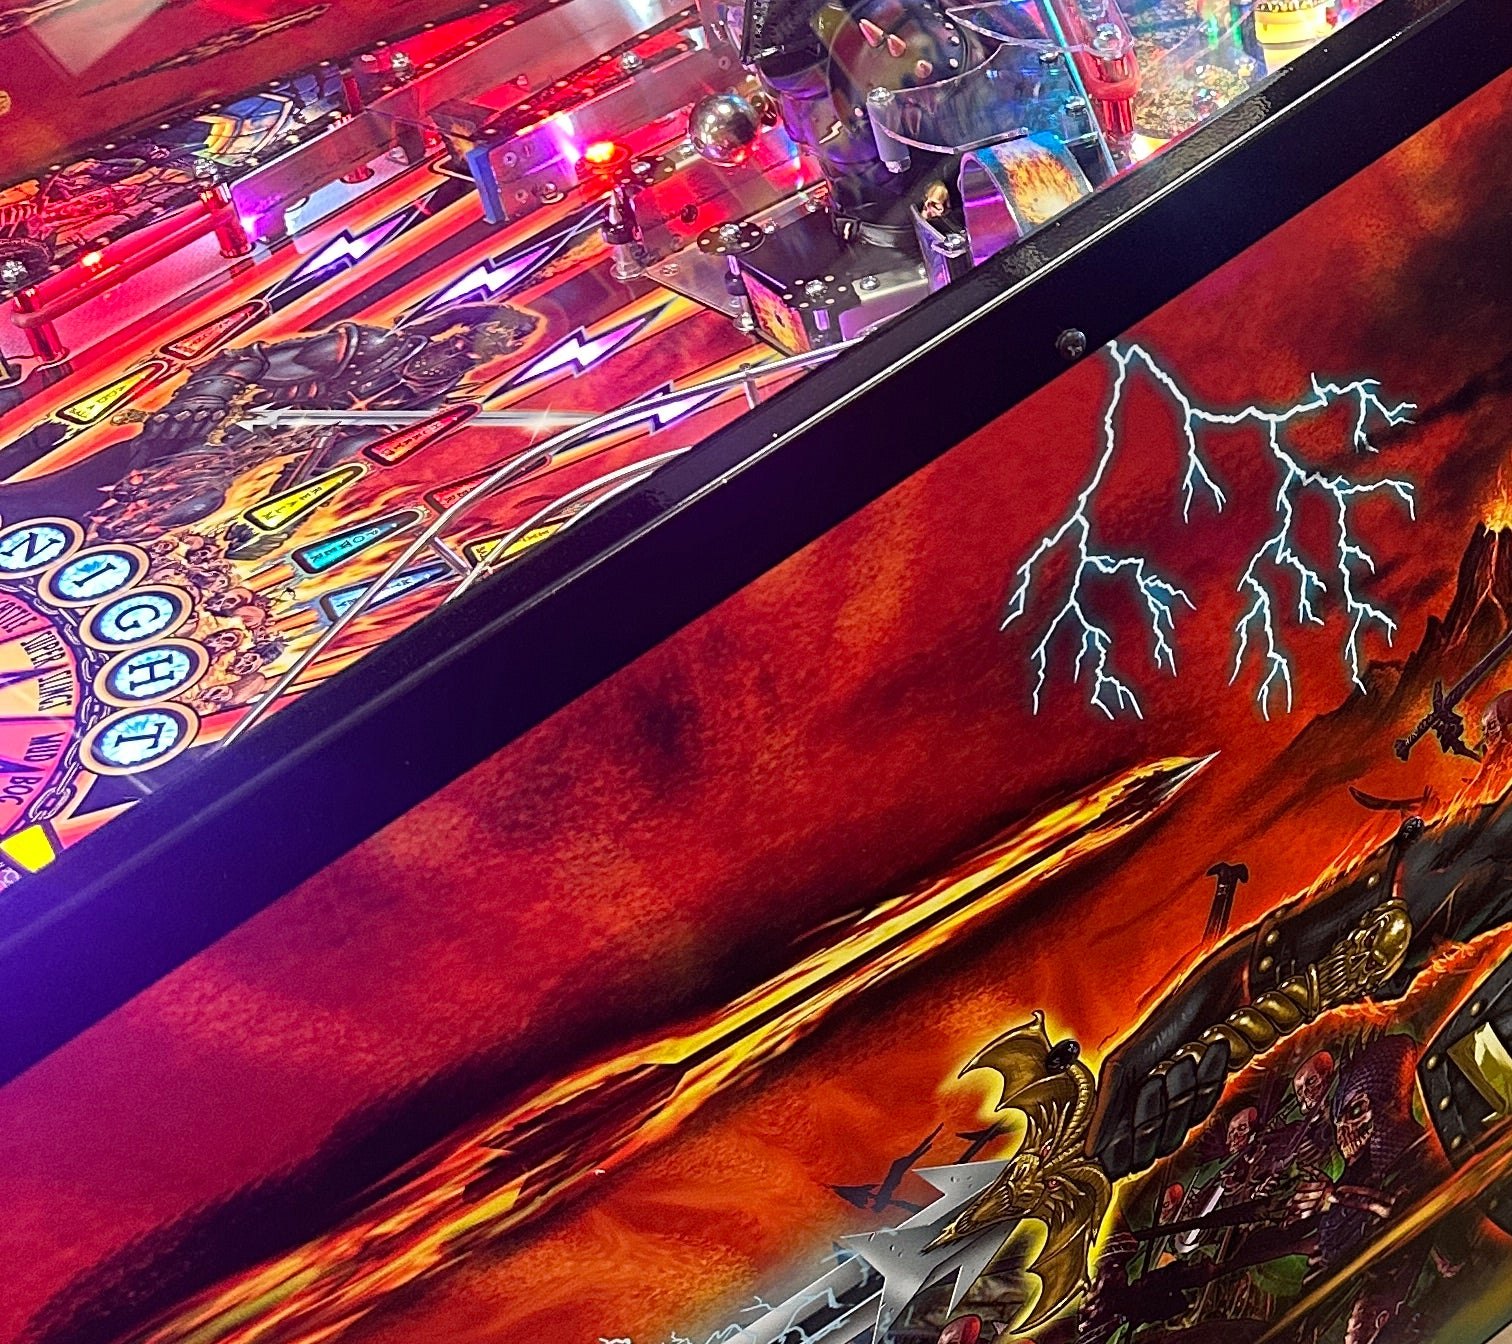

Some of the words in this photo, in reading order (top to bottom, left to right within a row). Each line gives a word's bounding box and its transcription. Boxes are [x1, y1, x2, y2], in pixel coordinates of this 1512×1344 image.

[21, 630, 67, 670] SUPER
[37, 669, 73, 712] SLINGS
[24, 731, 66, 763] MUD
[0, 776, 44, 806] BOG
